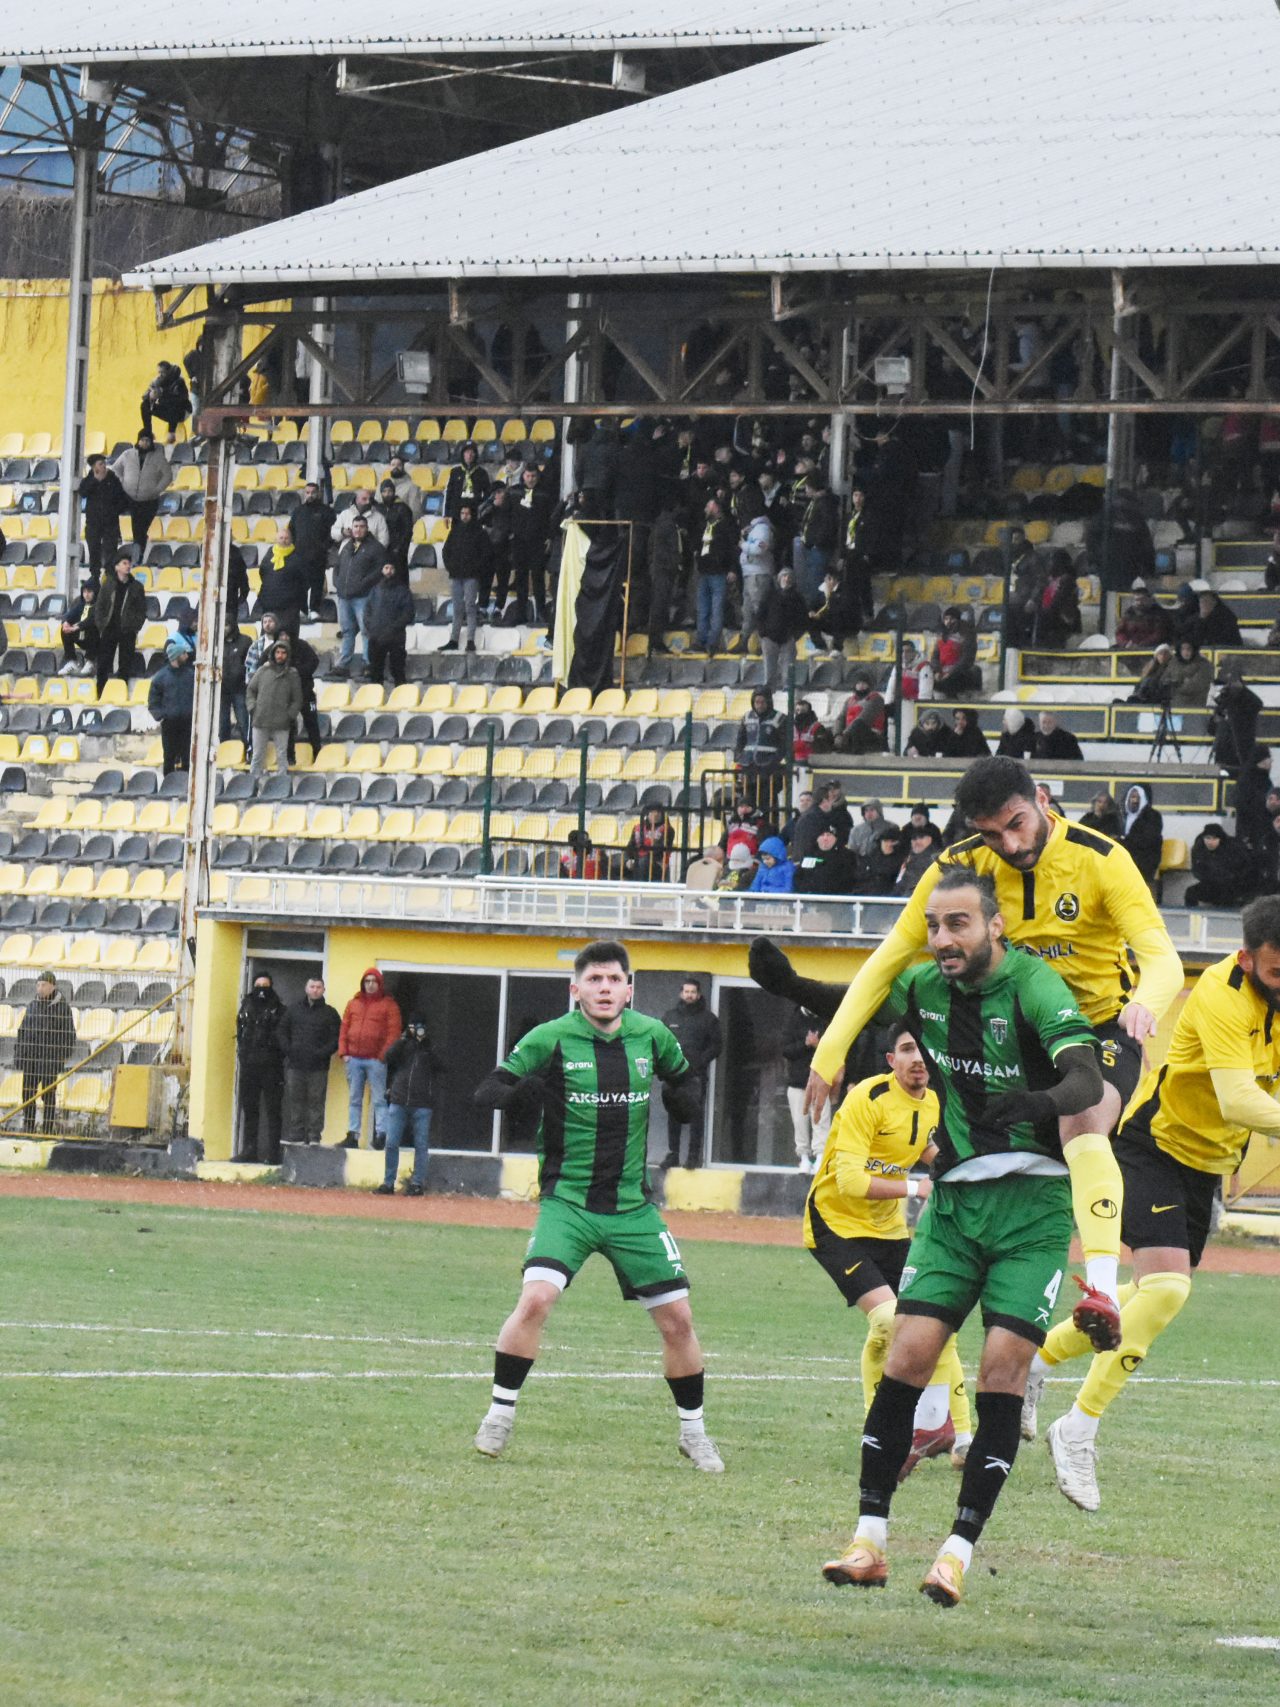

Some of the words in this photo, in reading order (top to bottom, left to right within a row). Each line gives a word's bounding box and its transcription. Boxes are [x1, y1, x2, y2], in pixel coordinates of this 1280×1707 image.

[575, 1061, 593, 1069] raru
[1103, 1050, 1116, 1067] 5
[1043, 1268, 1063, 1309] 4
